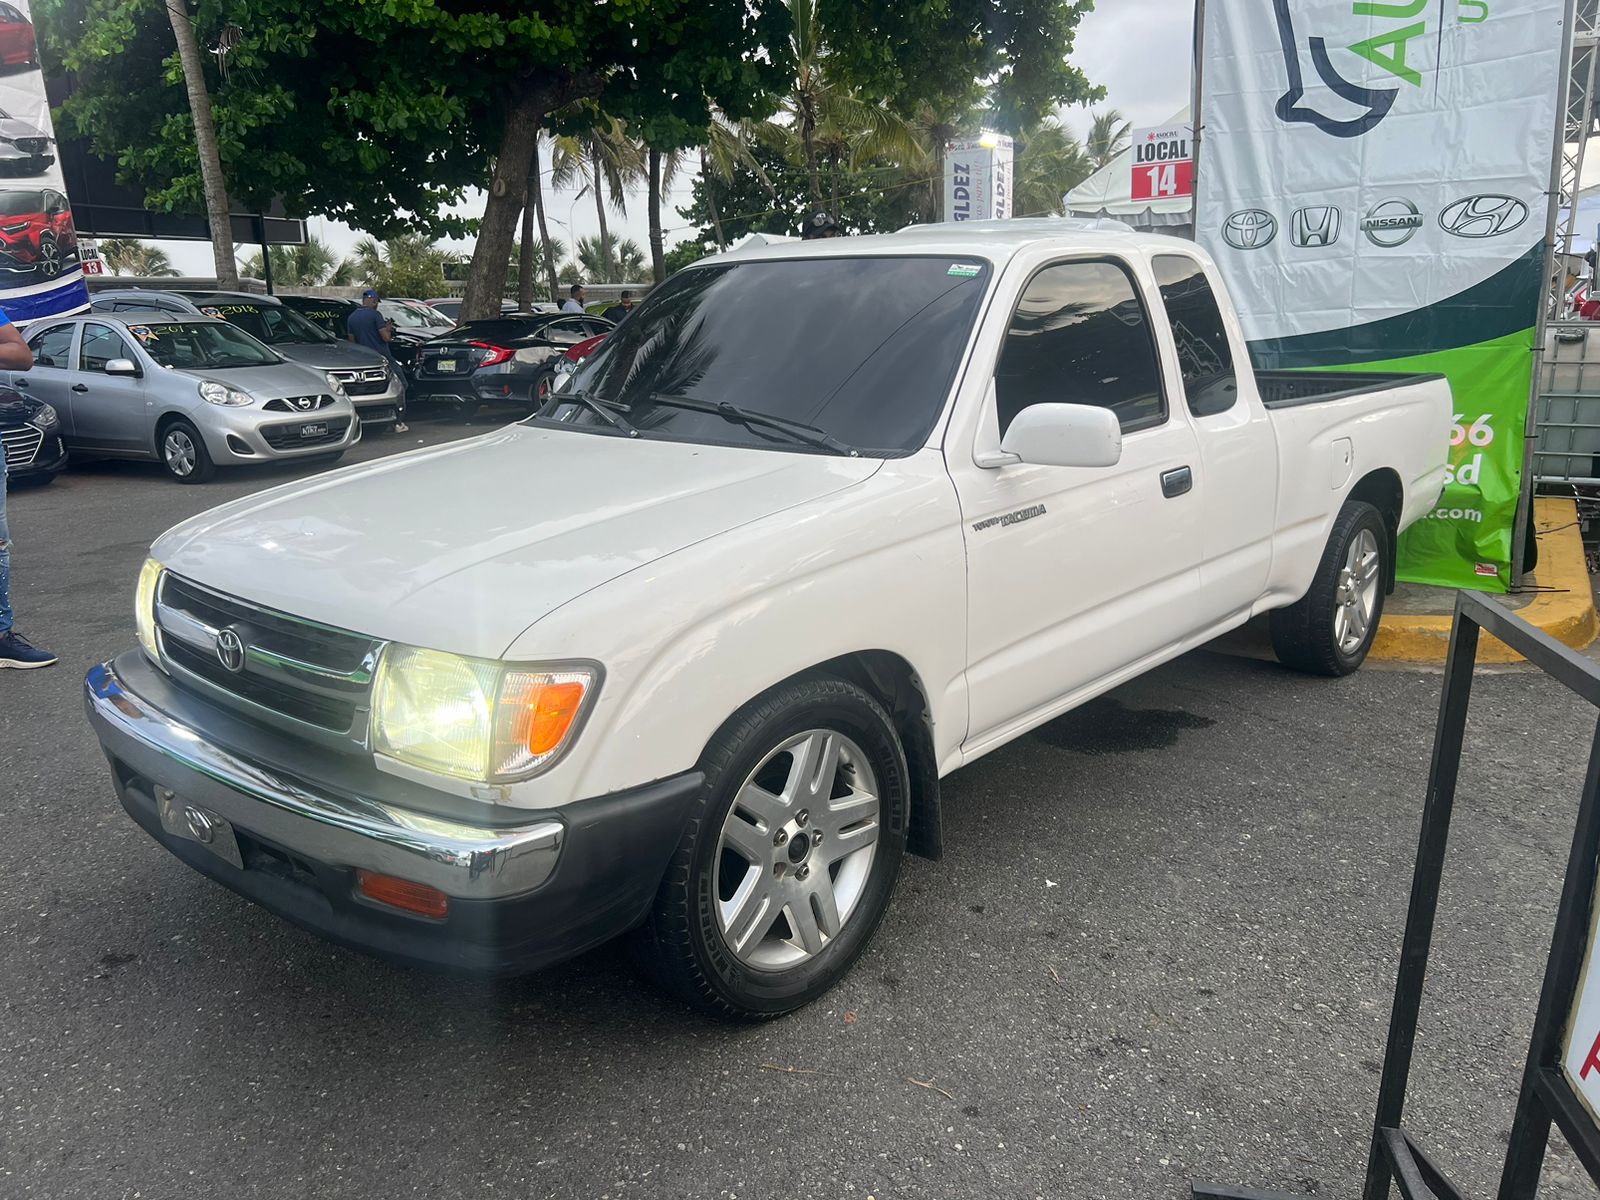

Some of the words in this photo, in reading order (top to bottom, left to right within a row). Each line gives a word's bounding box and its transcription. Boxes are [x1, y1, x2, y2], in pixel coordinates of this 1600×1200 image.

[1137, 139, 1188, 162] LOCAL
[1147, 165, 1177, 197] 14
[1366, 217, 1418, 227] NISSAN
[86, 262, 98, 273] 13
[220, 305, 259, 315] 2018
[1424, 508, 1482, 523] .com
